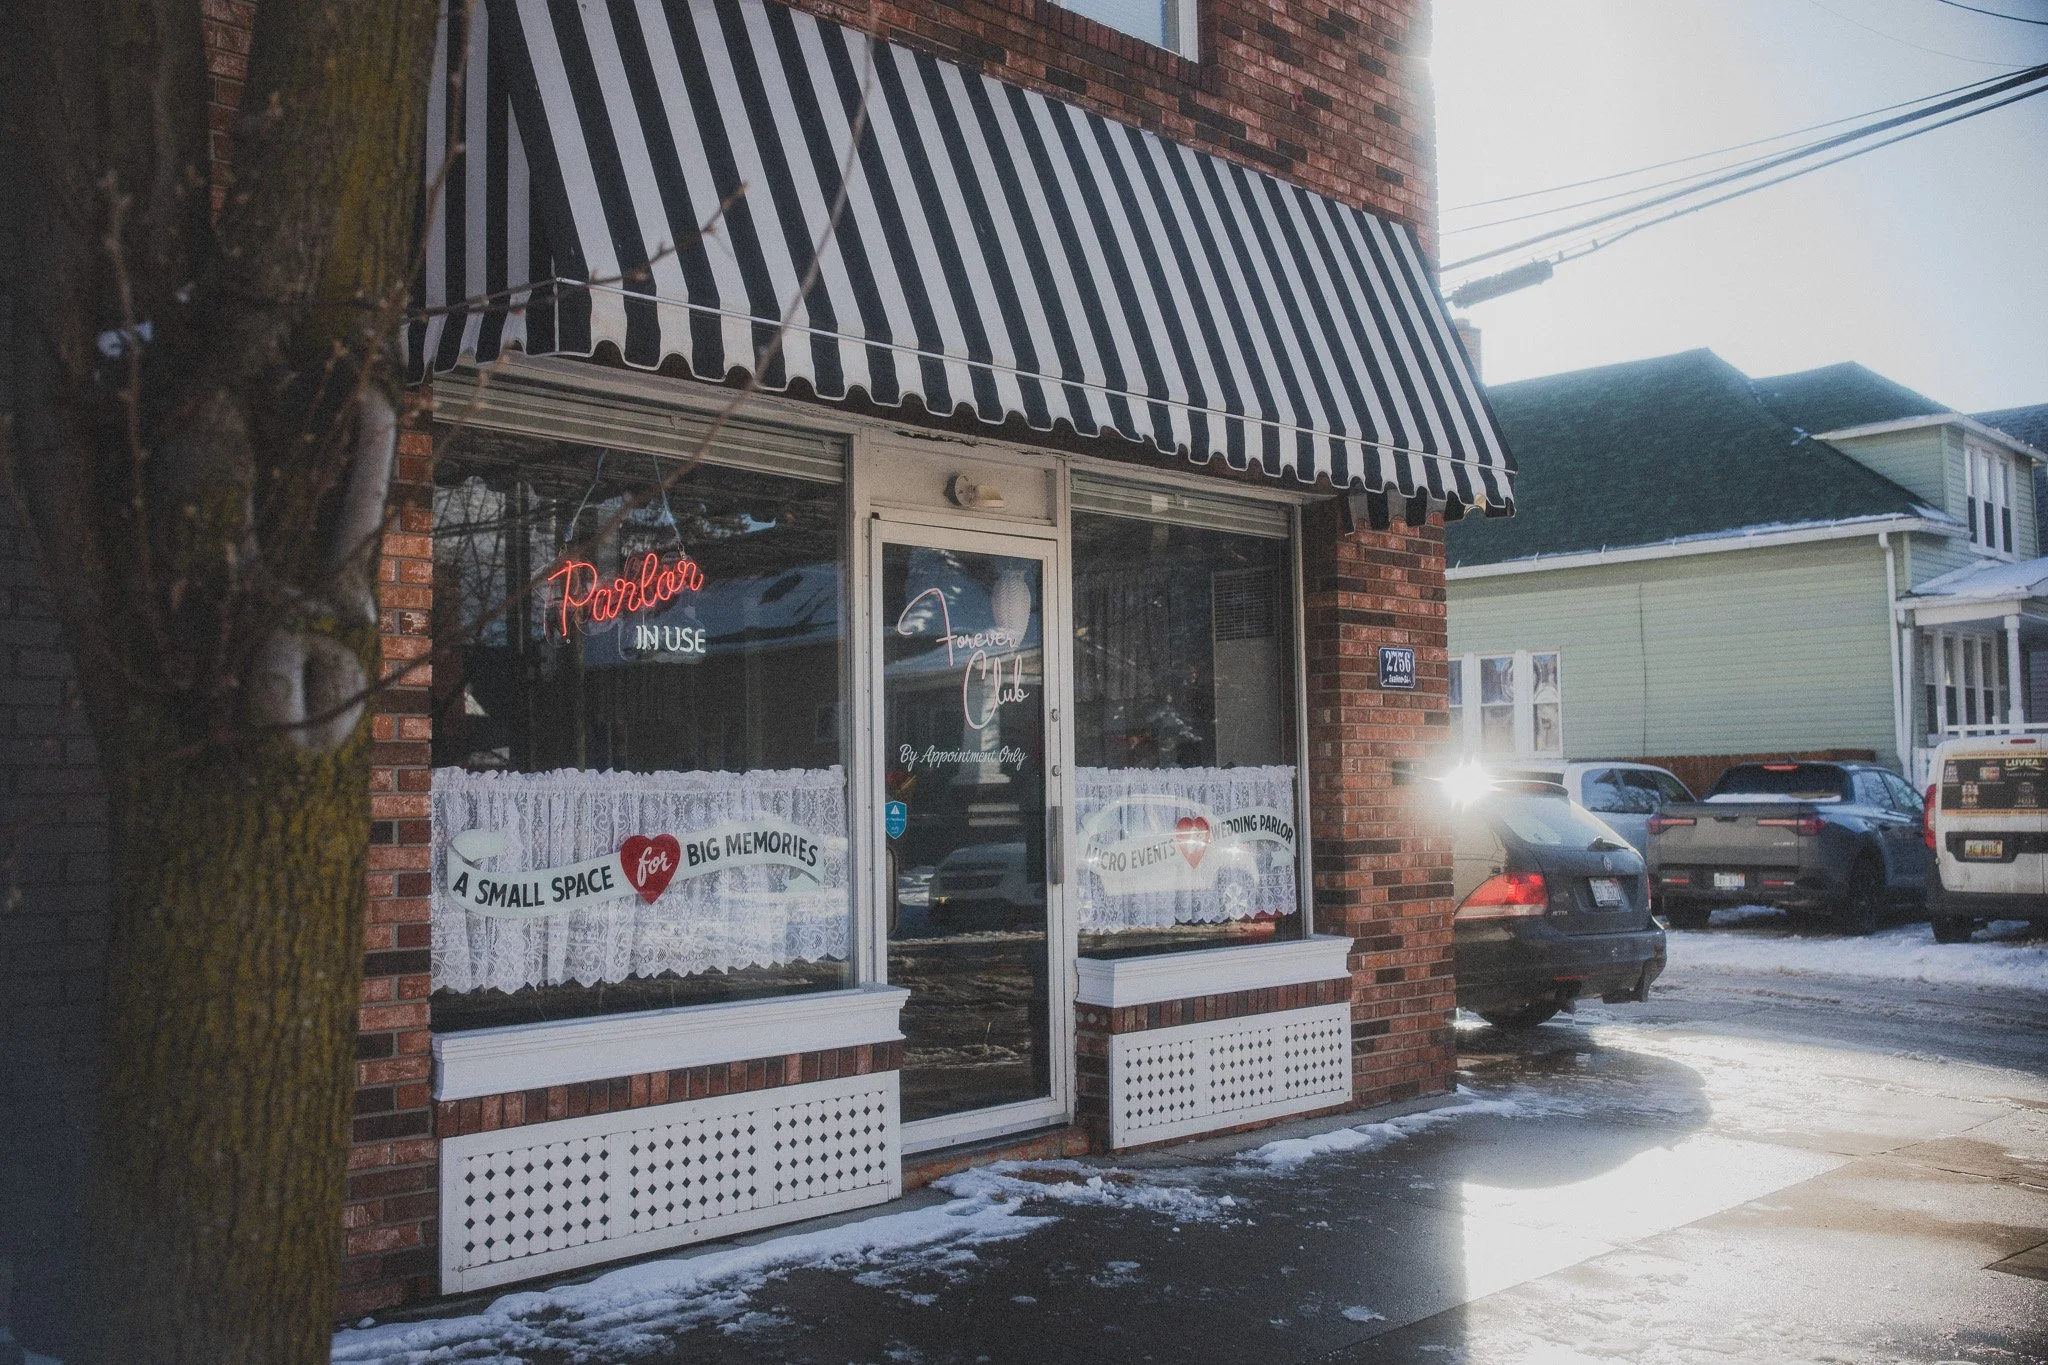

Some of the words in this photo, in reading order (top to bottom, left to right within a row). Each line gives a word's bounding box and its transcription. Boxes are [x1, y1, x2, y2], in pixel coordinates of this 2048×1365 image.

[548, 552, 705, 637] Parlor
[897, 587, 1017, 667] Forever
[636, 625, 659, 651] IN
[664, 625, 706, 654] USE
[1385, 651, 1411, 672] 2756
[963, 650, 1030, 730] Club
[900, 744, 918, 771] By
[919, 744, 996, 769] Appointment
[999, 744, 1027, 771] Only
[452, 872, 469, 898] A
[475, 879, 545, 908] SMALL
[552, 865, 614, 903] SPACE
[636, 846, 673, 887] for
[686, 842, 721, 867] BIG
[725, 830, 819, 867] MEMORIES
[1085, 844, 1127, 872] MICRO
[1131, 838, 1176, 869] EVENTS
[1211, 814, 1257, 841] WEDDING
[1260, 814, 1294, 844] PARLOR
